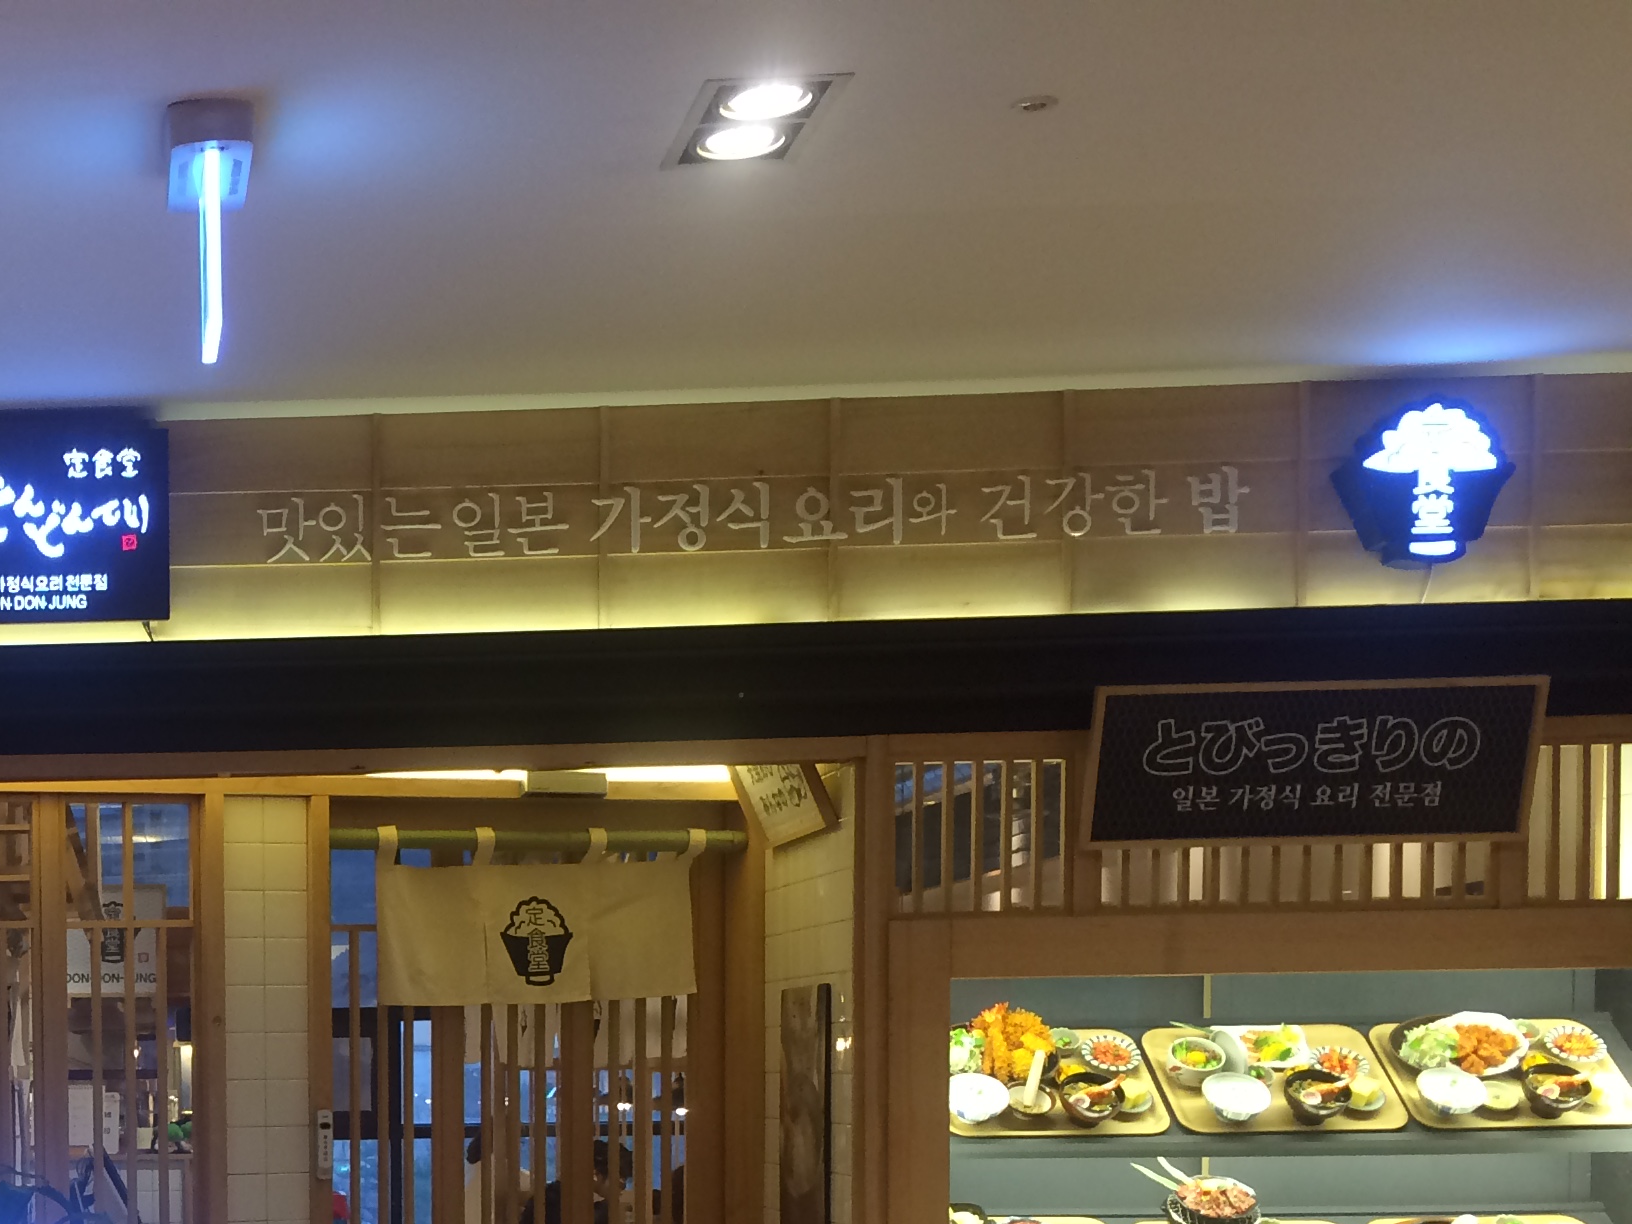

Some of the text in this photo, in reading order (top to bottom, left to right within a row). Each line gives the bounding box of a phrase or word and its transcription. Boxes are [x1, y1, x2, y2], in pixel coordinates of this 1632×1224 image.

[63, 448, 141, 479] 定食堂
[980, 468, 1168, 541] 건강한
[1186, 465, 1251, 534] 밥
[66, 573, 108, 591] 전문점
[1143, 716, 1480, 776] とびっきりの
[1172, 781, 1443, 812] 일본 가정식 요리 전문점
[526, 907, 549, 971] 定食堂
